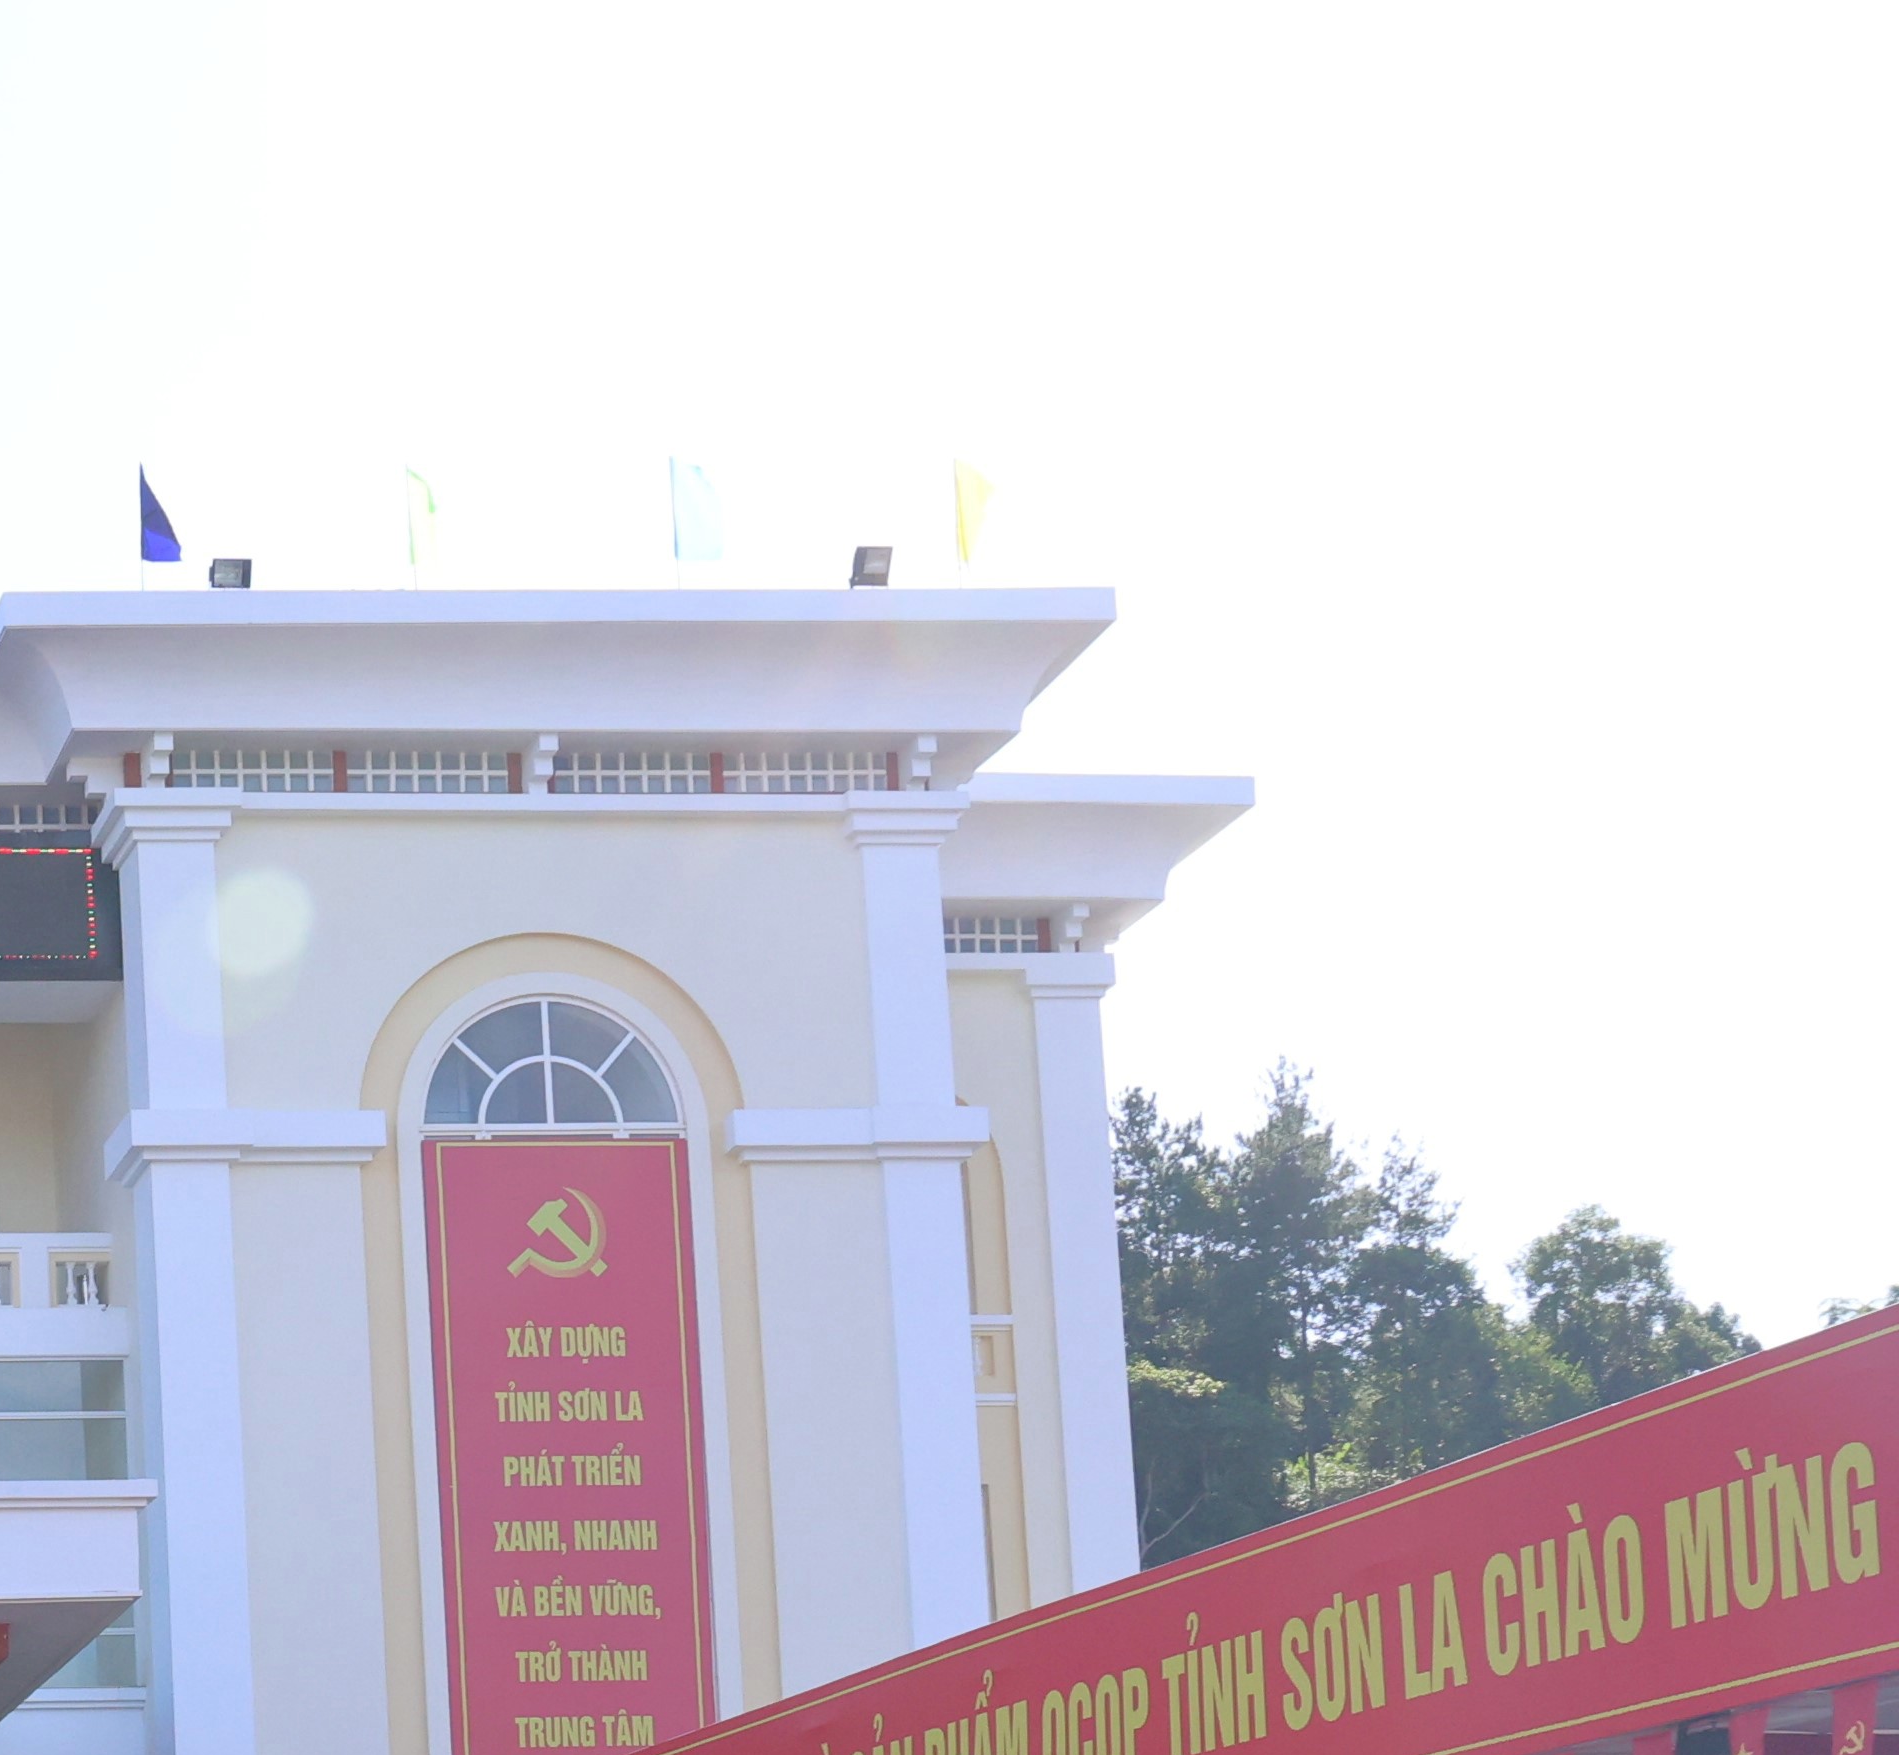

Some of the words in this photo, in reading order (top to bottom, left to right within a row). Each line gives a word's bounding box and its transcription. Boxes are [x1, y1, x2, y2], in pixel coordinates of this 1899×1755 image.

[506, 1321, 552, 1357] XÂY
[561, 1324, 625, 1363] DỰNG
[495, 1381, 550, 1422] TỈNH
[558, 1388, 607, 1421] SƠN
[615, 1391, 643, 1421] LA
[504, 1449, 565, 1486] PHÁT
[572, 1443, 641, 1485] TRIỂN
[494, 1521, 566, 1554] XANH,
[574, 1520, 657, 1550] NHANH
[495, 1580, 527, 1616] VÀ
[534, 1576, 582, 1616] BỀN
[590, 1580, 661, 1619] VỮNG,
[1281, 1592, 1385, 1730] SƠN
[1399, 1571, 1468, 1699] LA
[1483, 1503, 1644, 1676] CHÀO
[1665, 1442, 1880, 1628] MỪNG
[515, 1641, 561, 1682] TRỞ
[568, 1644, 647, 1681] THÀNH
[515, 1716, 595, 1747] TRUNG
[602, 1709, 654, 1746] TÂM
